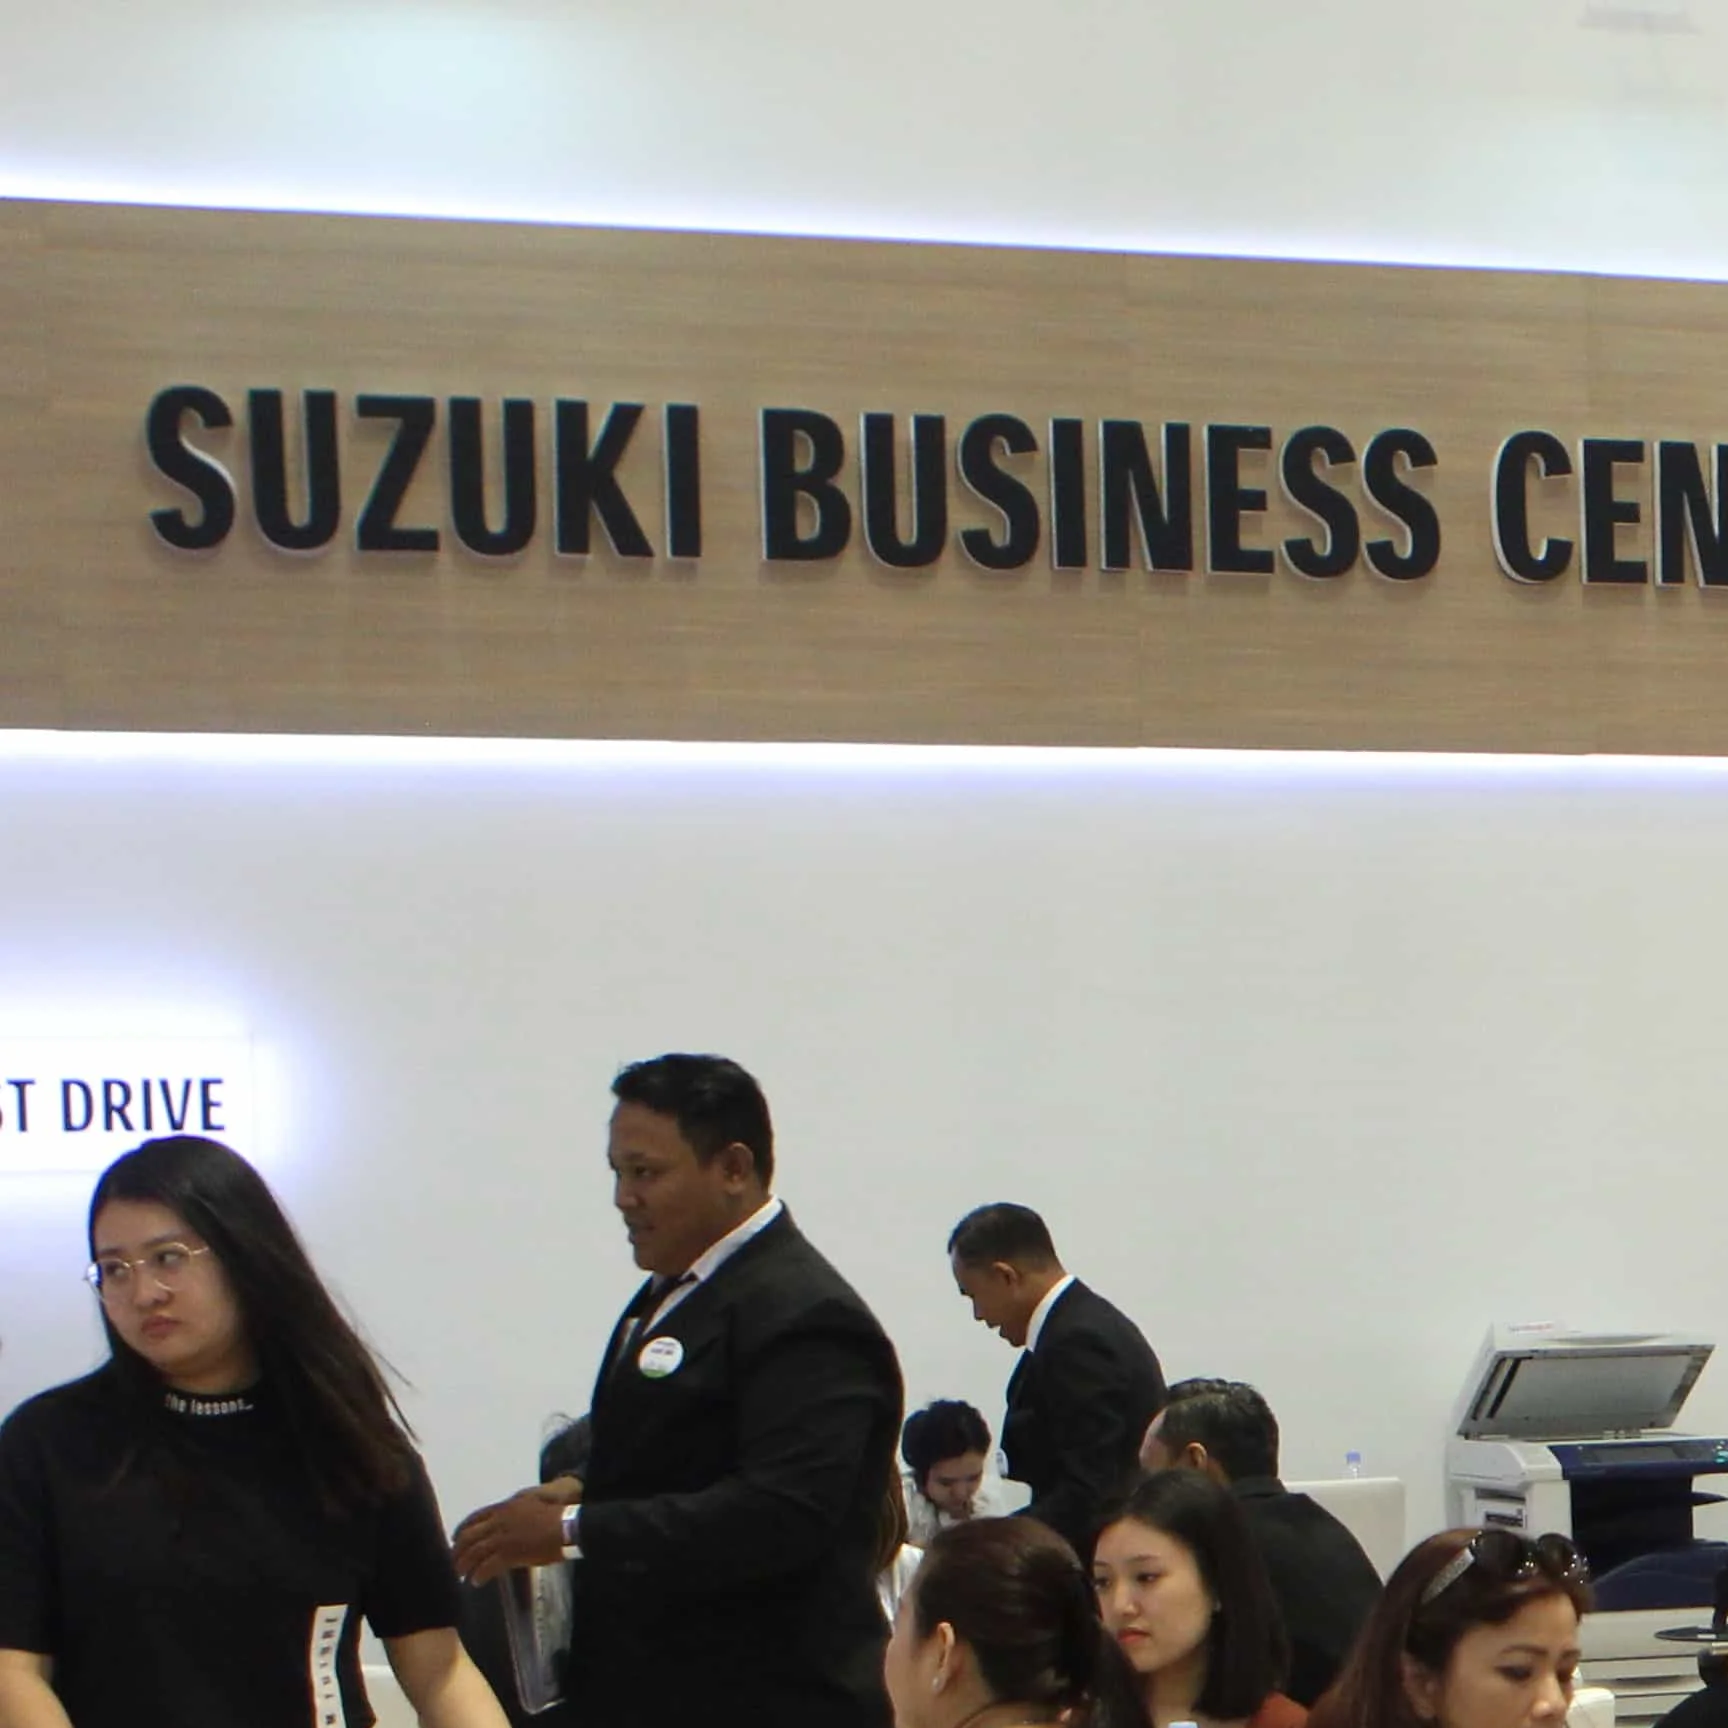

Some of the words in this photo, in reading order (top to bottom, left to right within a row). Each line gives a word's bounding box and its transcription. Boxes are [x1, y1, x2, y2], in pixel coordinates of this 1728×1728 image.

[144, 384, 704, 559] SUZUKI
[759, 406, 1442, 583] BUSINESS
[0, 1078, 36, 1132] T
[60, 1077, 226, 1132] DRIVE
